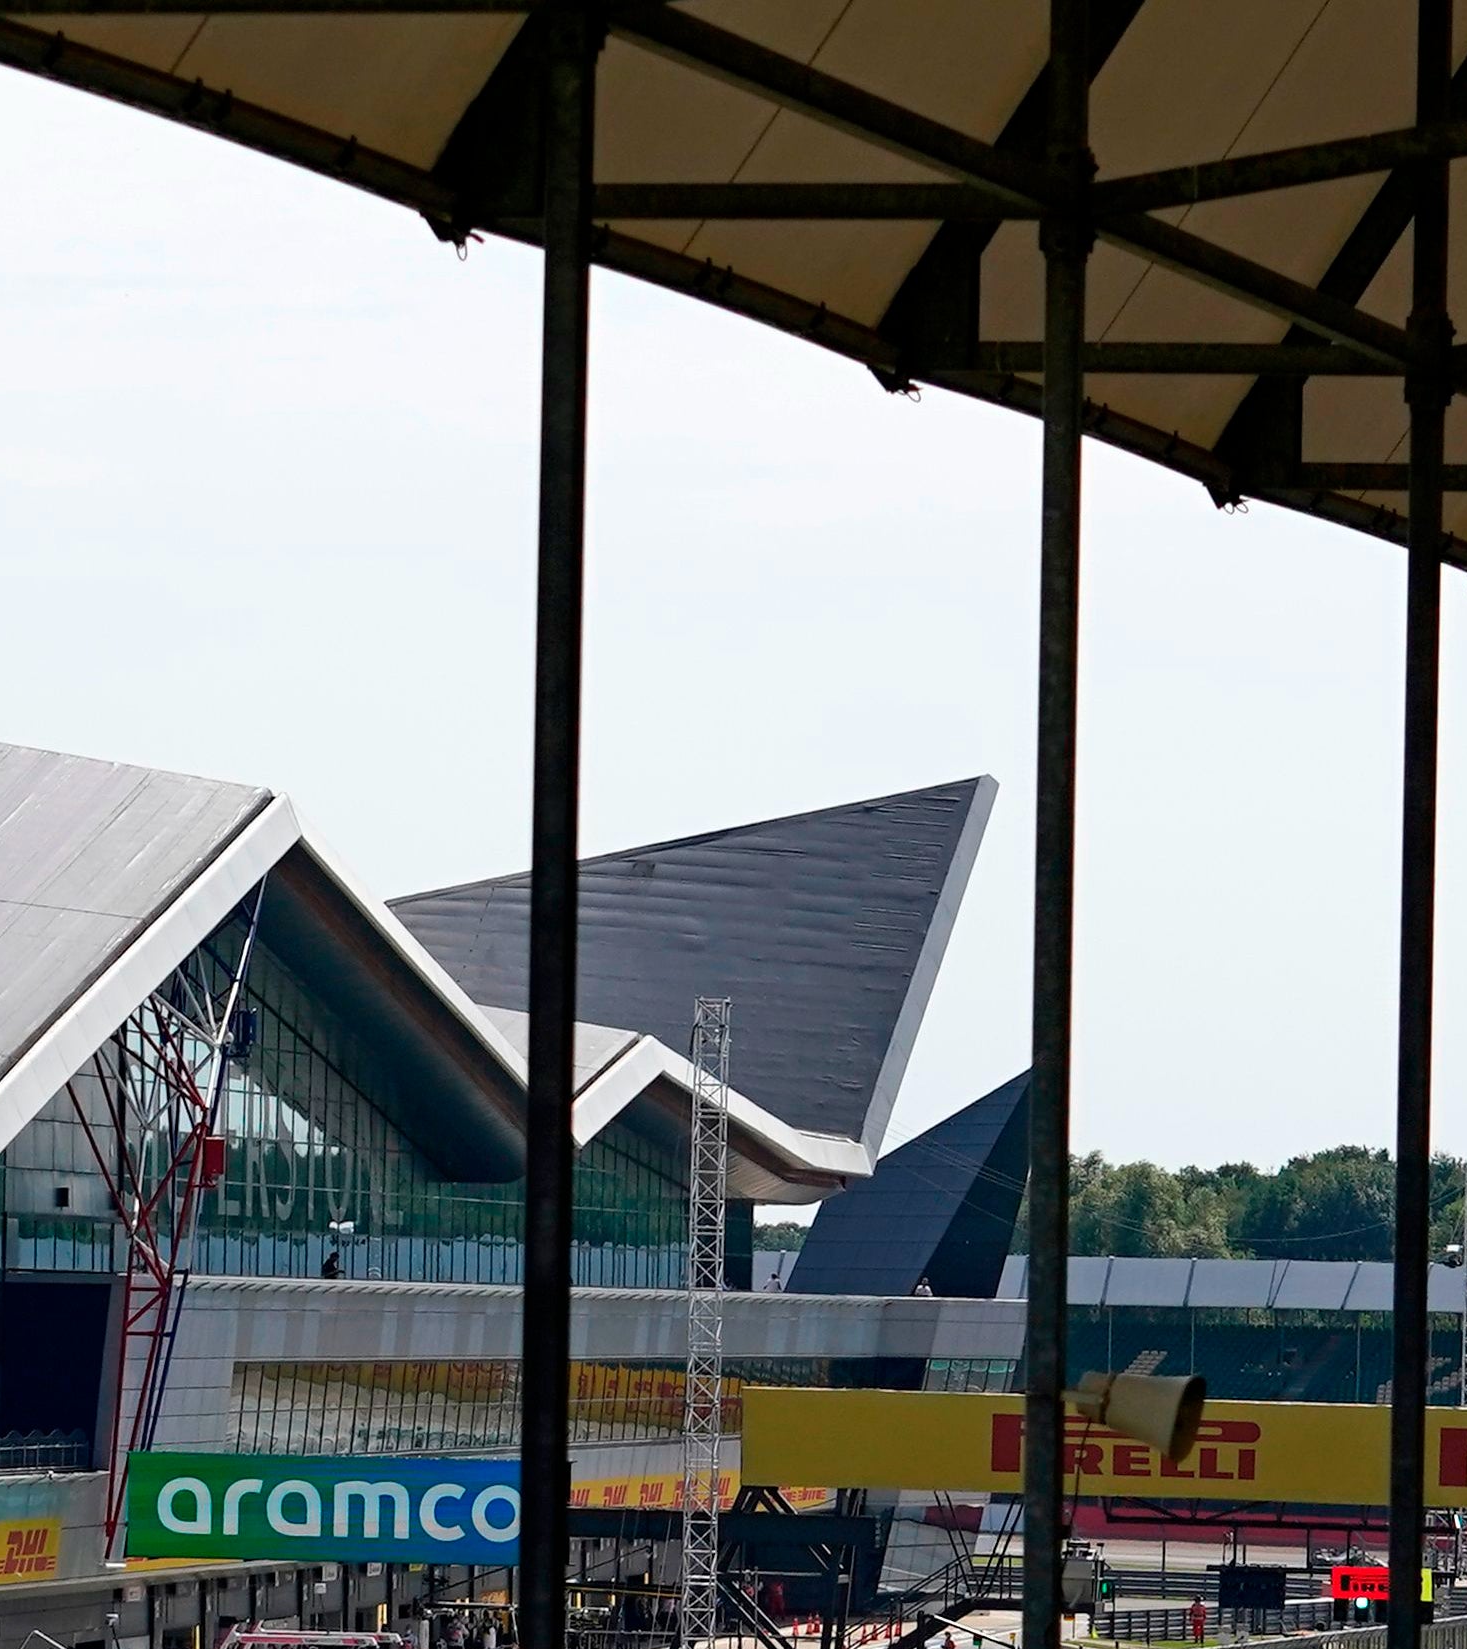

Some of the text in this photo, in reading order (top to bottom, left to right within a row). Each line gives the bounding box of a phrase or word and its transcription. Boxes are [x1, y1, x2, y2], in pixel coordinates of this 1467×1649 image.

[991, 1413, 1261, 1480] PRELLI
[157, 1476, 521, 1542] aramco
[2, 1529, 48, 1574] DHL
